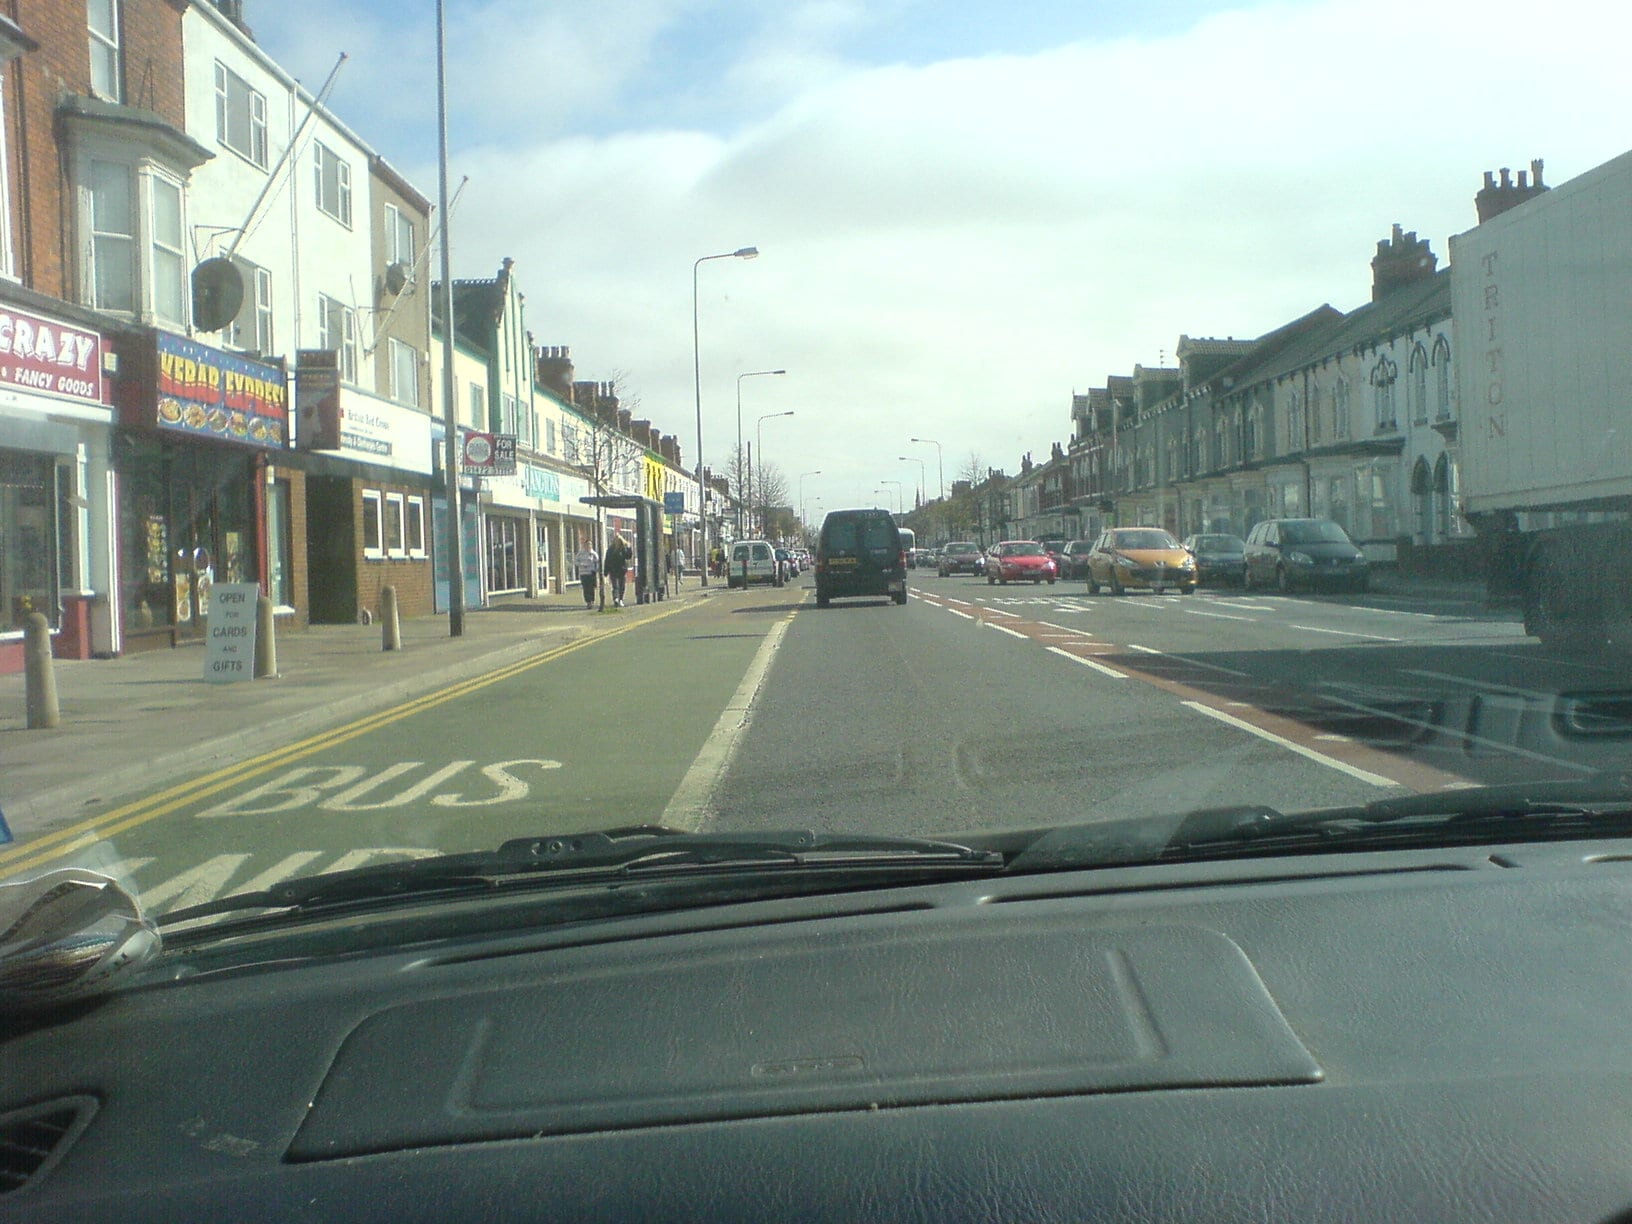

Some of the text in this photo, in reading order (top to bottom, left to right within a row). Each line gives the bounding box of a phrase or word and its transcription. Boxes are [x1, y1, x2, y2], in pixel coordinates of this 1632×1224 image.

[0, 314, 94, 372] CRAZY
[1481, 250, 1505, 439] TRITON
[14, 366, 53, 389] FANCY
[57, 376, 94, 396] GOODS
[496, 439, 512, 449] FOR
[494, 450, 515, 461] SALE
[219, 591, 246, 603] OPEN
[225, 611, 240, 619] FOR
[212, 625, 248, 638] CARDS
[222, 644, 238, 653] AND
[212, 660, 243, 673] GIFTS
[194, 758, 562, 818] BUS
